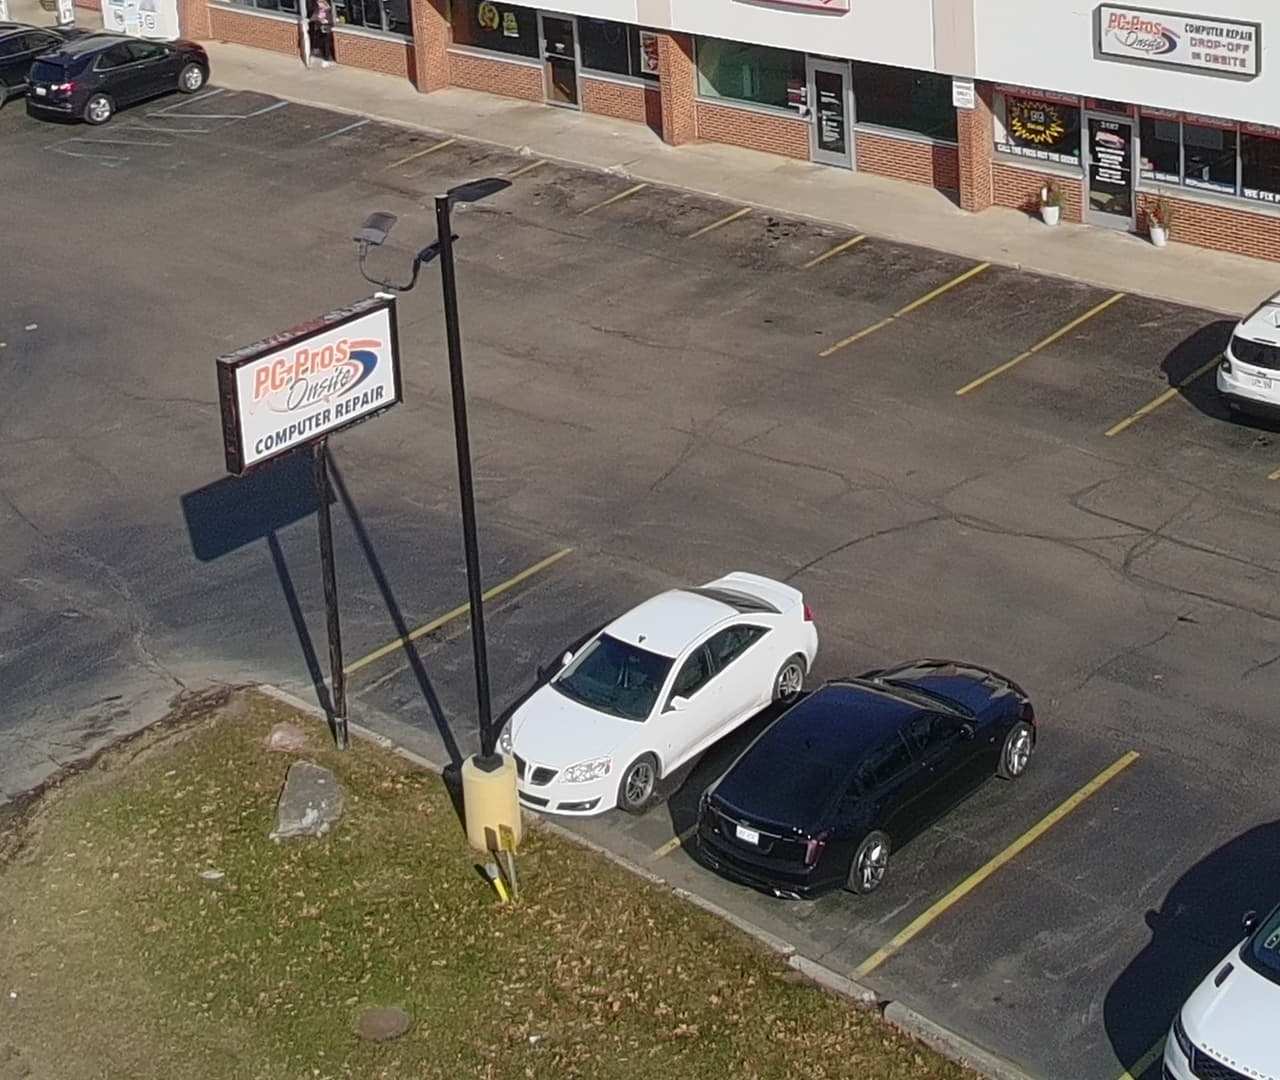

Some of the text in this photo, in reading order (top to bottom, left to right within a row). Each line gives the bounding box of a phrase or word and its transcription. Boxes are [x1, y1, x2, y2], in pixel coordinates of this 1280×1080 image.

[1108, 12, 1162, 36] PC-Pros
[1184, 23, 1252, 41] COMPUTER REPAIR
[1125, 30, 1165, 50] Onsite
[1190, 37, 1249, 54] DROP-OFF
[1204, 53, 1247, 68] ONSITE
[1244, 188, 1258, 199] WE
[1259, 190, 1273, 202] FIX
[254, 338, 349, 401] PC-Pros
[287, 367, 352, 411] Onsite
[255, 385, 384, 455] COMPUTER REPAIR
[1201, 1042, 1275, 1080] RANGE ROV
